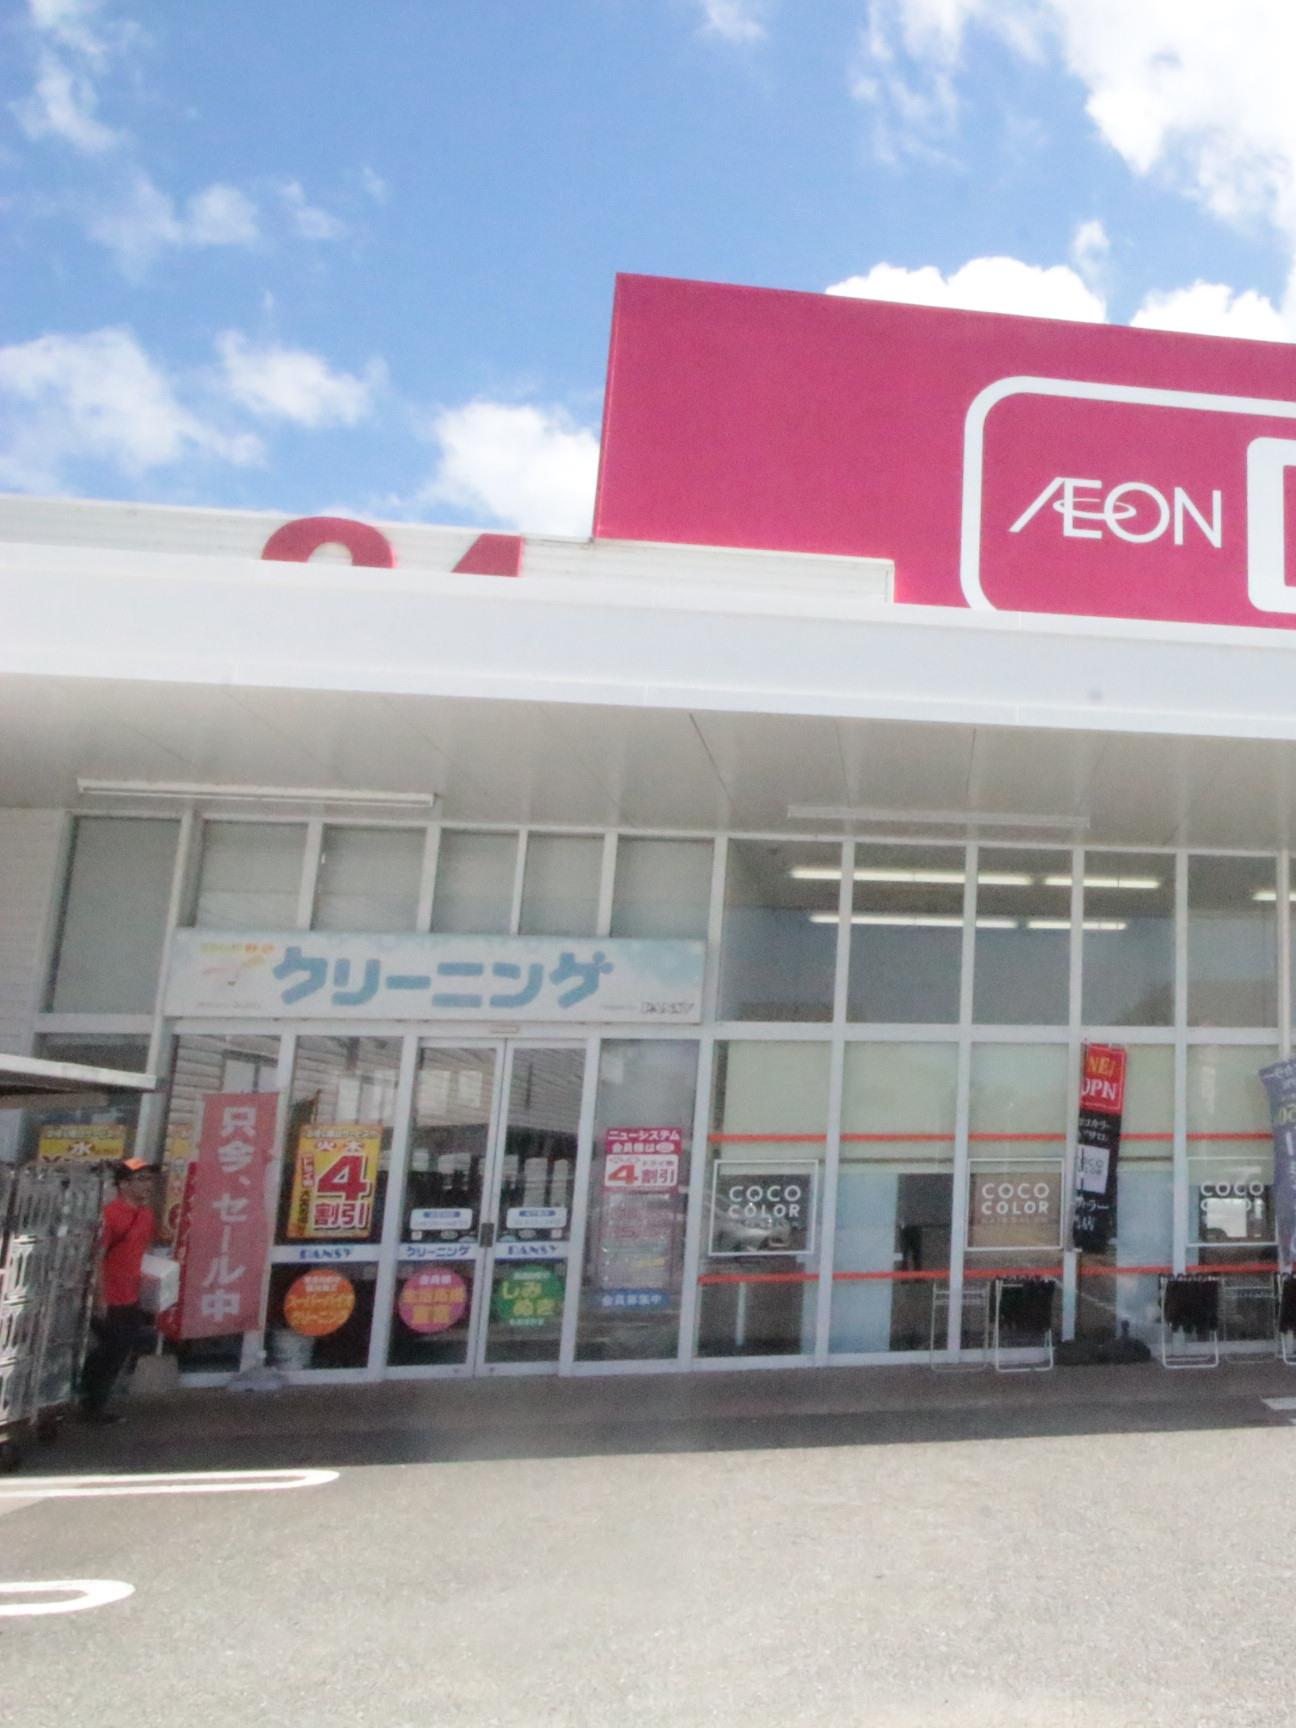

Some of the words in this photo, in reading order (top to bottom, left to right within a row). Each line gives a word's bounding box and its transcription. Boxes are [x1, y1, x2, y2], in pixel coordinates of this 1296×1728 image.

[272, 946, 614, 1009] クリーニング
[608, 1129, 681, 1141] ニューシステム
[317, 1154, 368, 1202] 4
[728, 1184, 802, 1202] COCO
[981, 1183, 1050, 1199] COCO
[1200, 1181, 1265, 1197] COCO
[201, 1105, 258, 1322] 只今、セール中
[314, 1202, 367, 1227] 割引
[727, 1202, 801, 1218] COLOR
[981, 1200, 1049, 1216] COLOR
[405, 1245, 472, 1258] クリーニング
